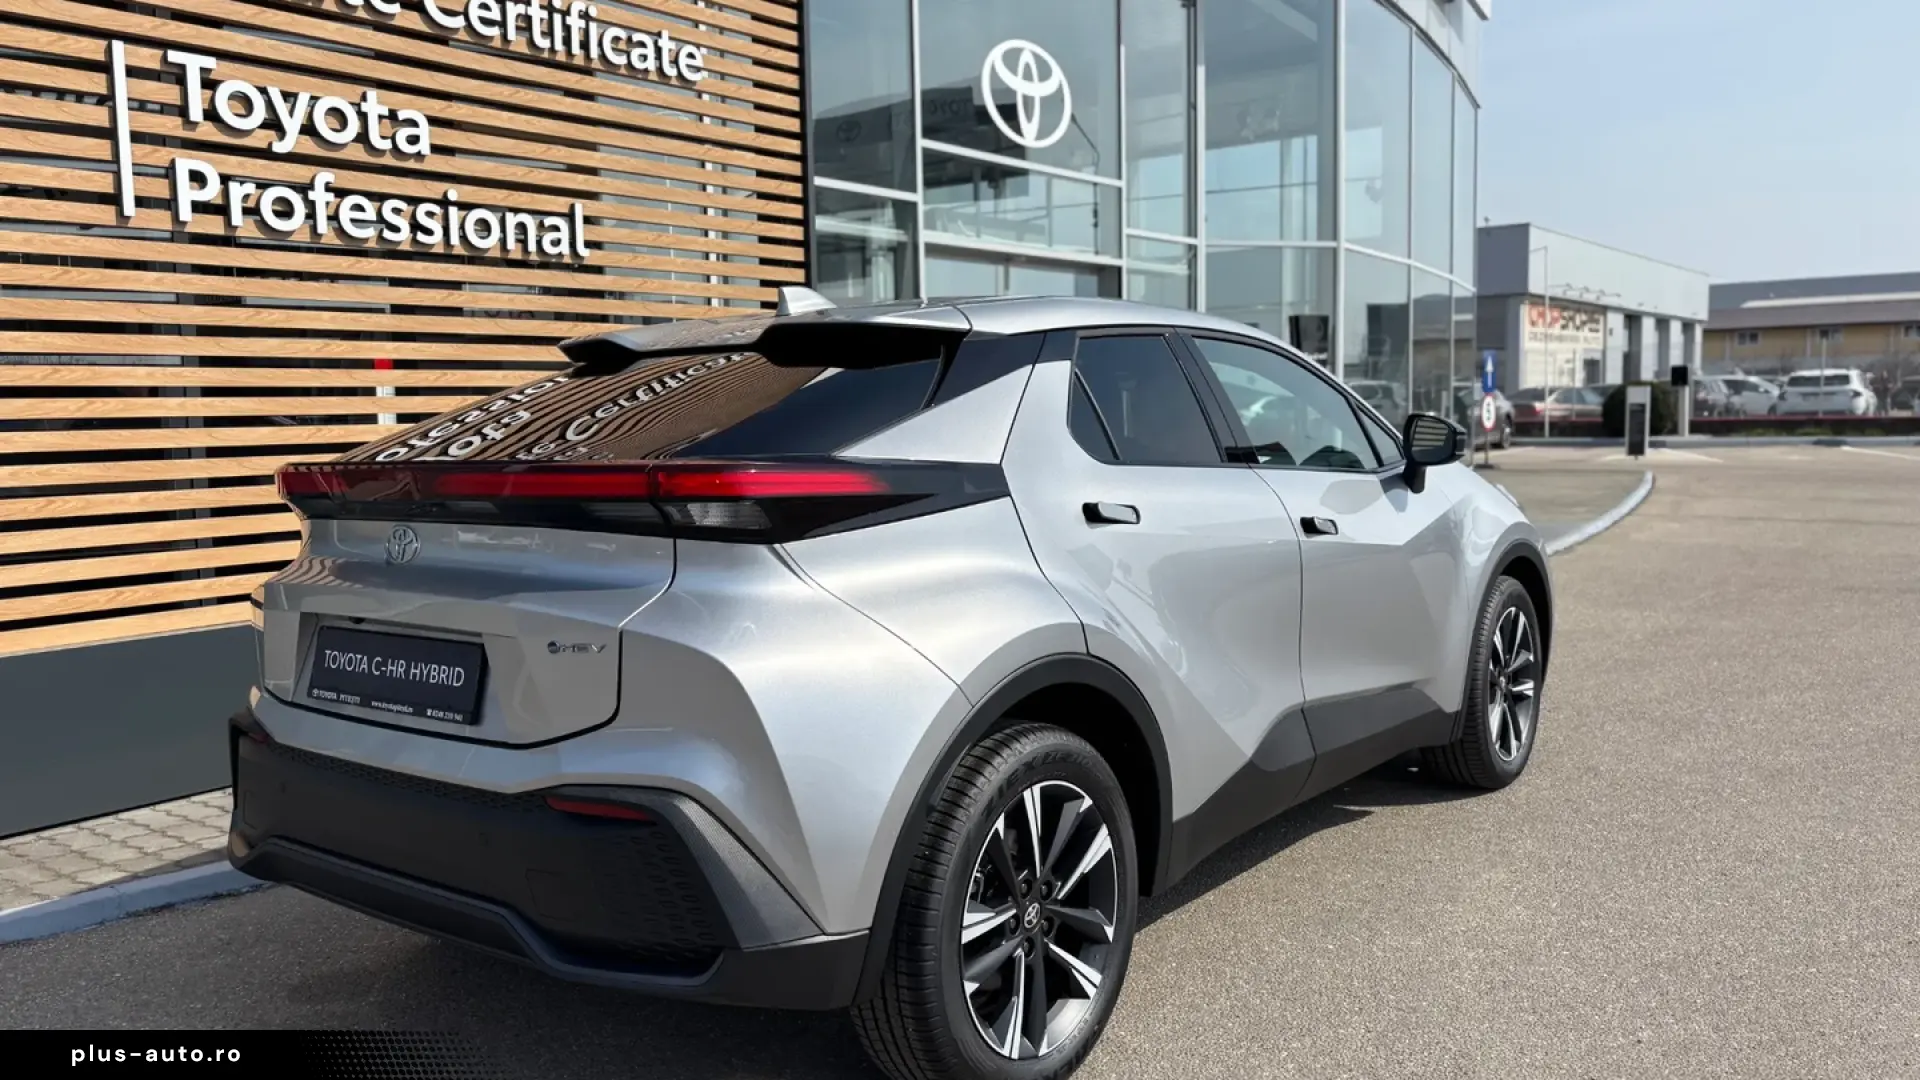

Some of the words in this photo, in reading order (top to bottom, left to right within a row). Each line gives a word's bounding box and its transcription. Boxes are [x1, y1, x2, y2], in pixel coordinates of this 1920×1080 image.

[166, 50, 432, 155] Toyota
[174, 157, 590, 258] Professional
[324, 650, 368, 674] TOYOTA
[371, 656, 406, 679] C-HR
[409, 661, 465, 687] HYBRID
